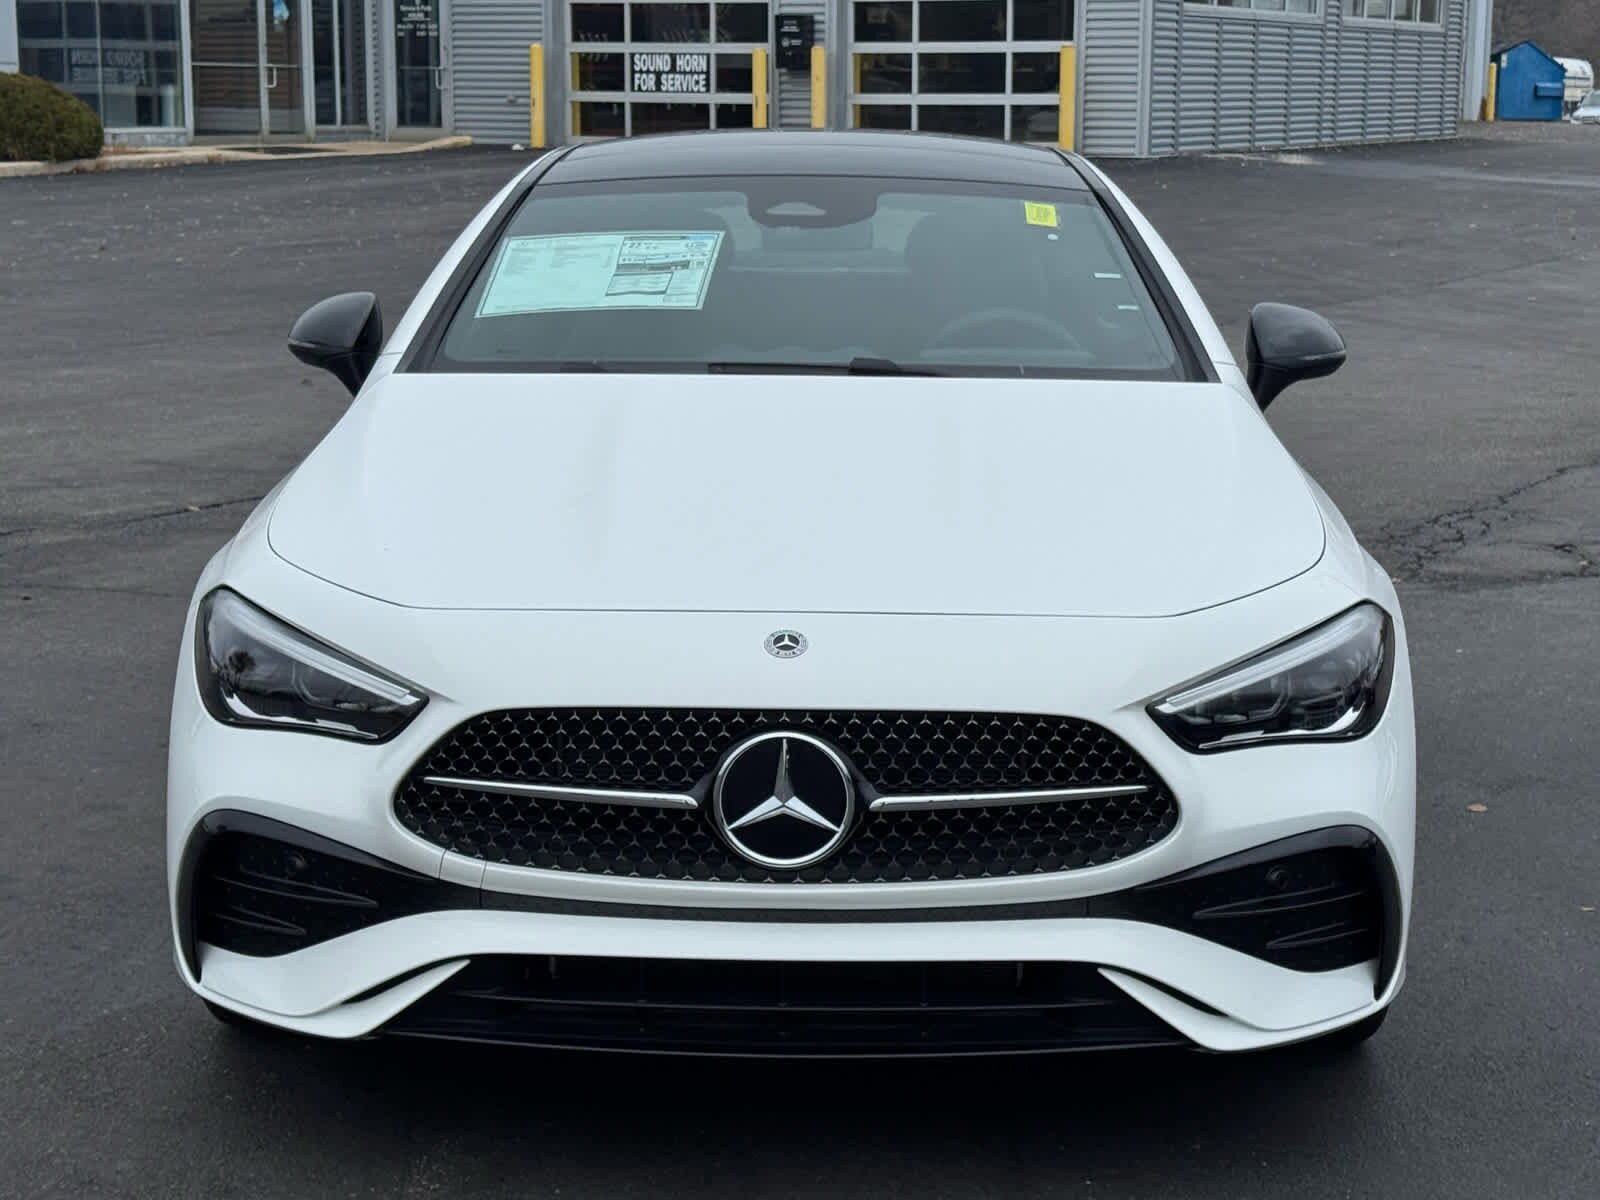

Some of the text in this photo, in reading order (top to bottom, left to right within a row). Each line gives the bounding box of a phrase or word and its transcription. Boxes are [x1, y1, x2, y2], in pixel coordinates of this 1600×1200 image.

[634, 54, 707, 72] SOUND HORN
[634, 73, 706, 92] FOR SERVICE
